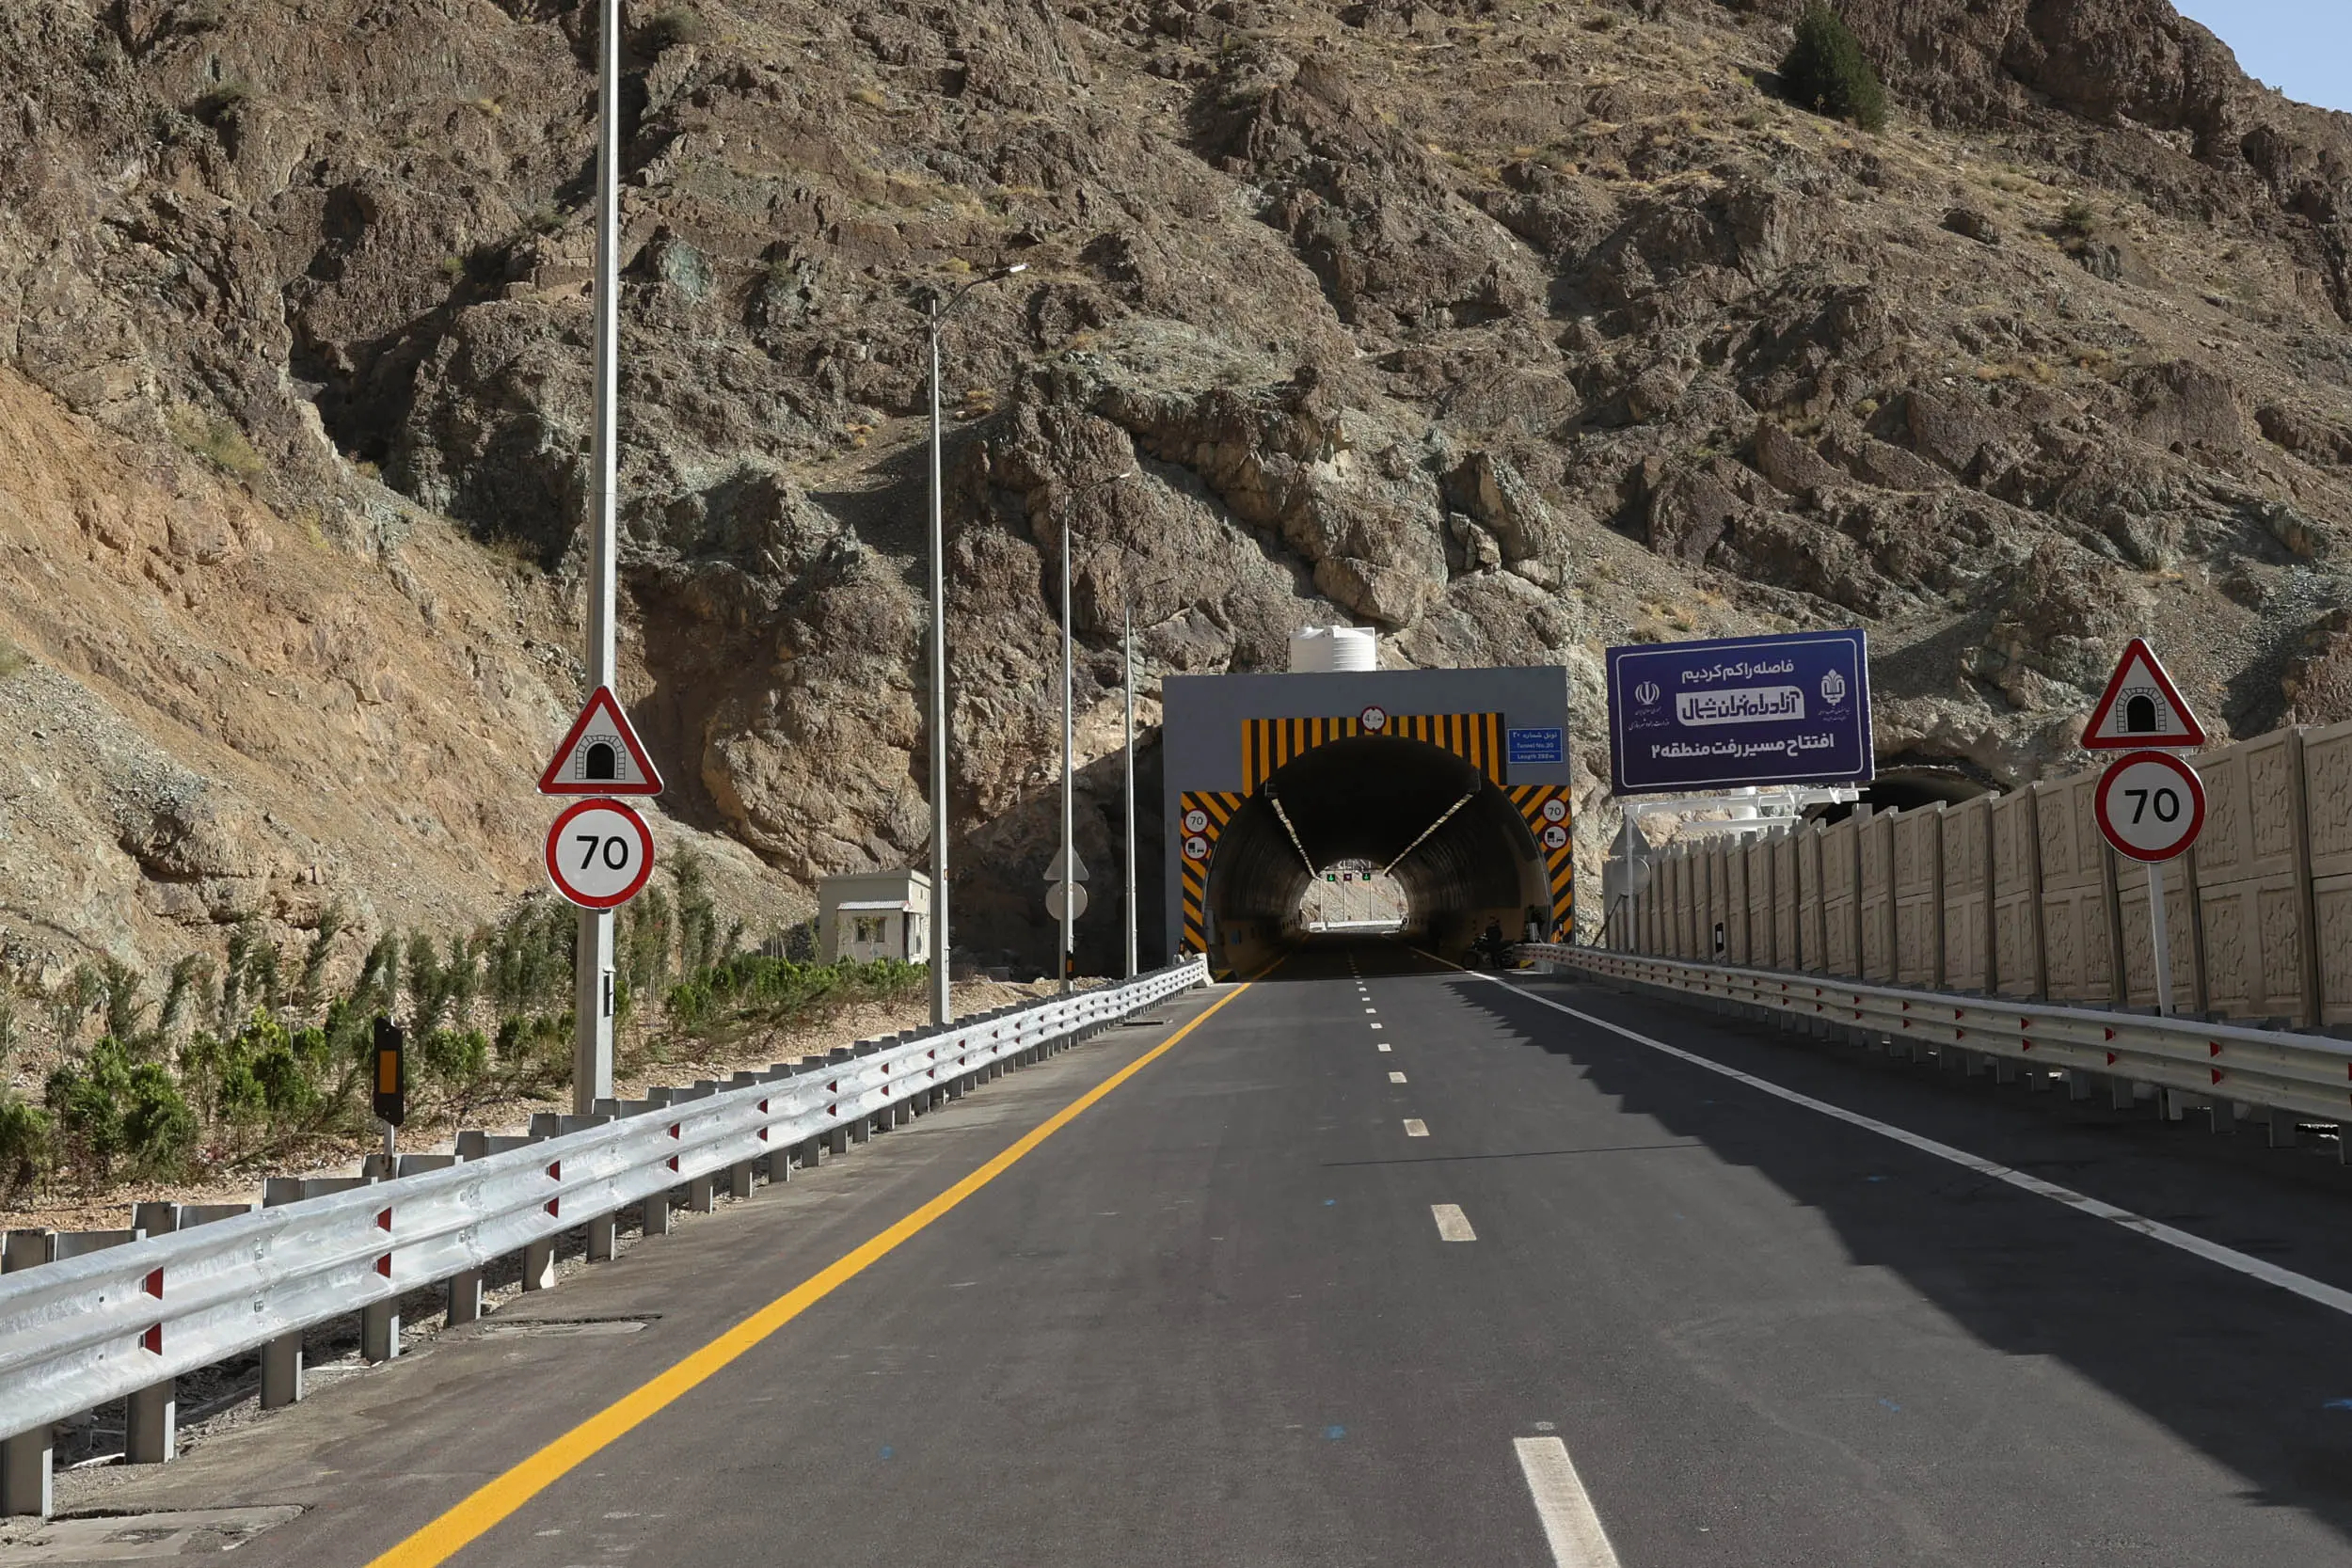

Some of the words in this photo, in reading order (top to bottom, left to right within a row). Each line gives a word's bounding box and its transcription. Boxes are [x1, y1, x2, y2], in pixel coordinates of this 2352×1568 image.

[1681, 664, 1723, 684] کردیم
[1723, 662, 1744, 681] کم
[1744, 662, 1753, 679] را
[1754, 658, 1794, 674] فاصله
[1661, 742, 1710, 758] منطقه
[1711, 738, 1742, 757] رفت
[1742, 739, 1785, 757] مسیر
[1787, 733, 1835, 757] افتتاح
[1548, 806, 1562, 816] 70
[2124, 787, 2180, 825] 70
[1190, 816, 1204, 826] 70
[576, 835, 628, 871] 70
